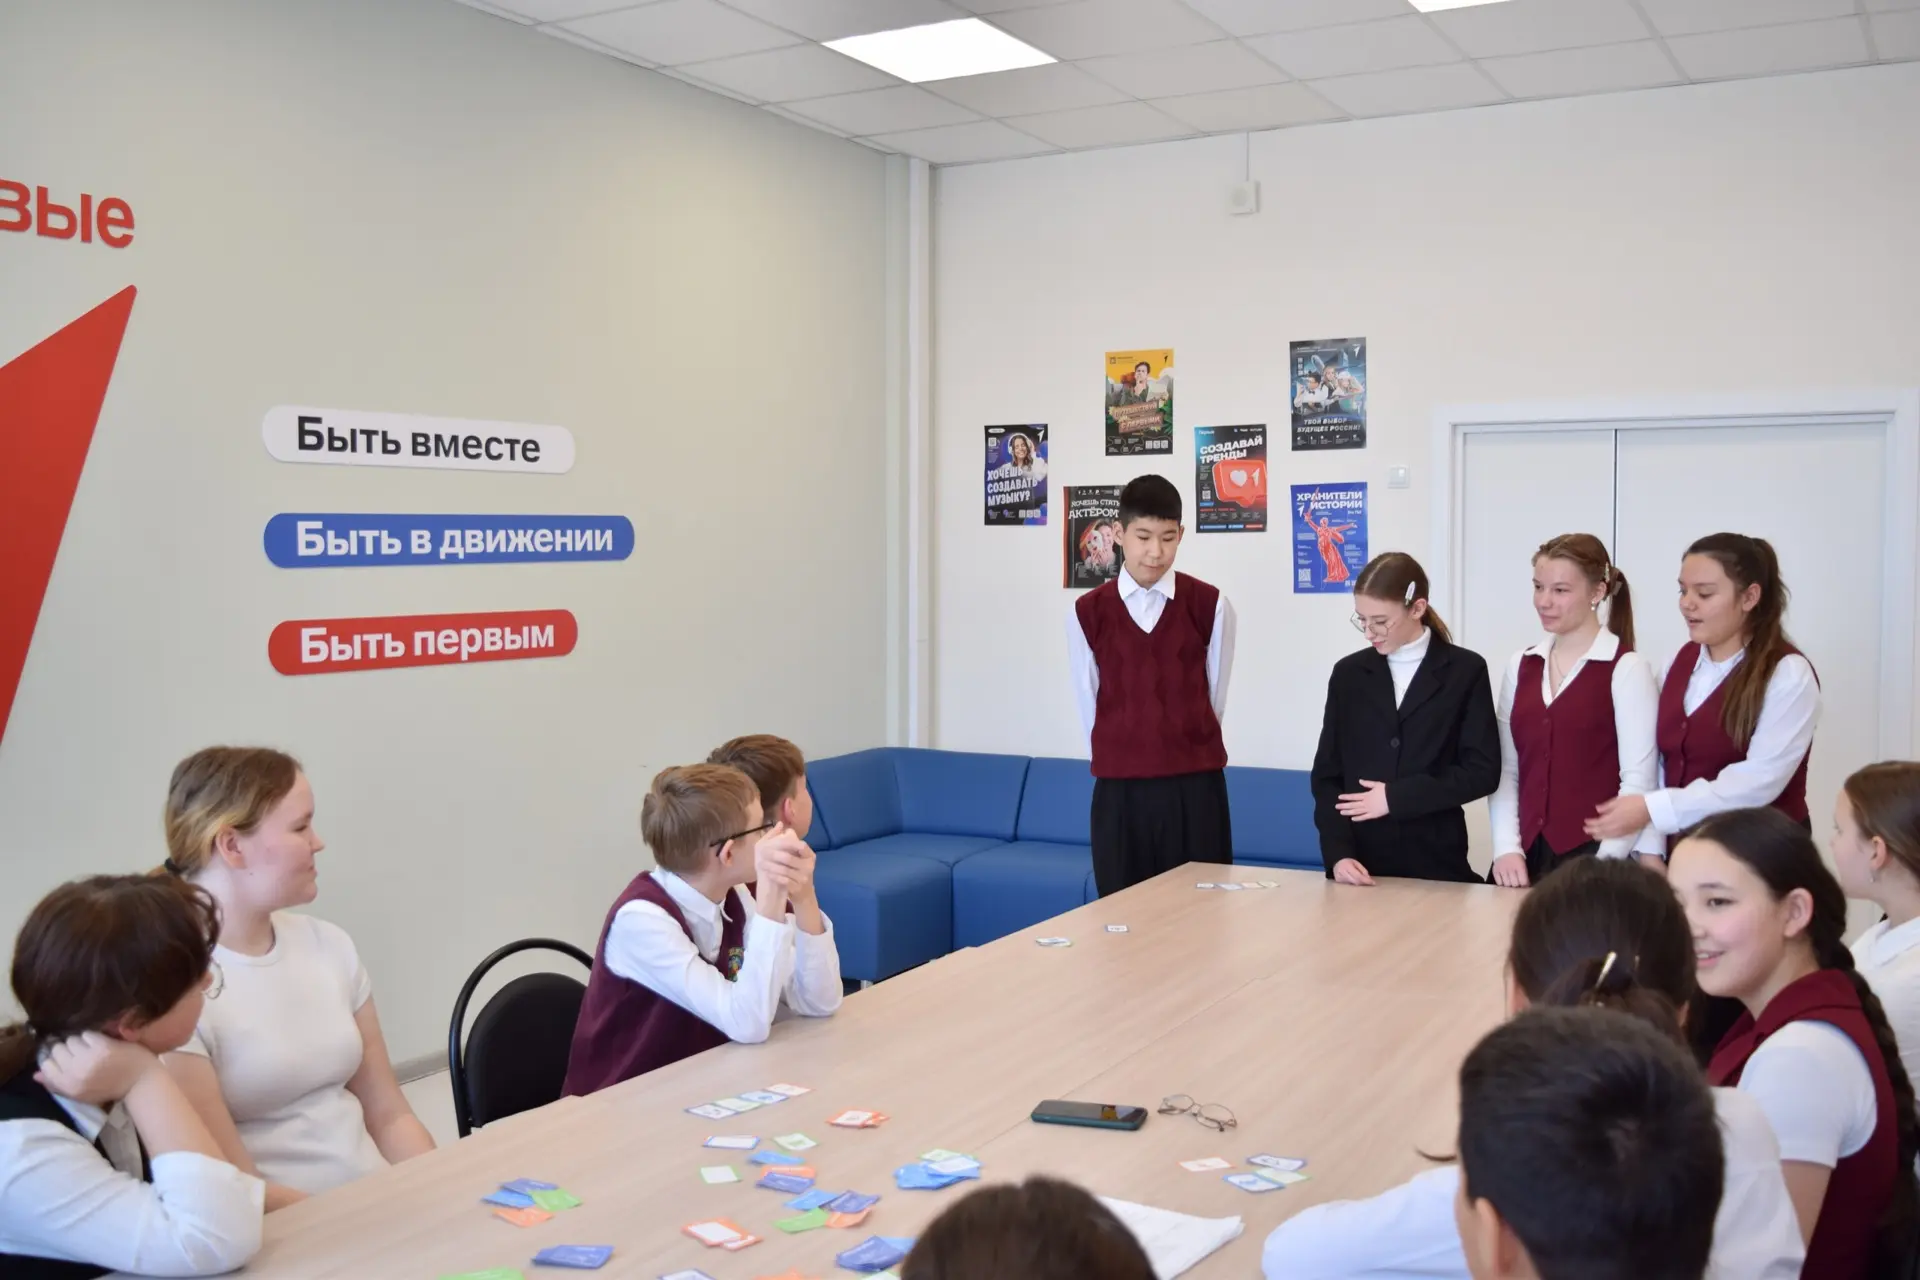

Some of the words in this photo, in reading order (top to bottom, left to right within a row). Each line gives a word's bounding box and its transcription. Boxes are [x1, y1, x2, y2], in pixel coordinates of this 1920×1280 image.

[298, 415, 401, 455] Быть
[411, 432, 541, 462] вместе
[1200, 435, 1263, 455] СОЗДАВАЙ
[1200, 449, 1247, 464] ТРЕНДЫ
[987, 468, 1023, 481] ХОЧЕШЬ
[987, 478, 1038, 494] СОЗДАВАТЬ
[988, 490, 1030, 507] МУЗЫКУ?
[1071, 499, 1099, 507] ХОЧЕШЬ
[1100, 499, 1120, 507] СТАТЬ
[1296, 491, 1362, 501] ХРАНИТЕЛИ
[1310, 500, 1362, 510] ИСТОРИИ
[1068, 506, 1119, 520] АКТЁРОМ
[297, 521, 401, 556] Быть
[411, 529, 432, 554] в
[440, 527, 612, 559] движении
[301, 627, 405, 663] Быть
[413, 624, 554, 661] первым
